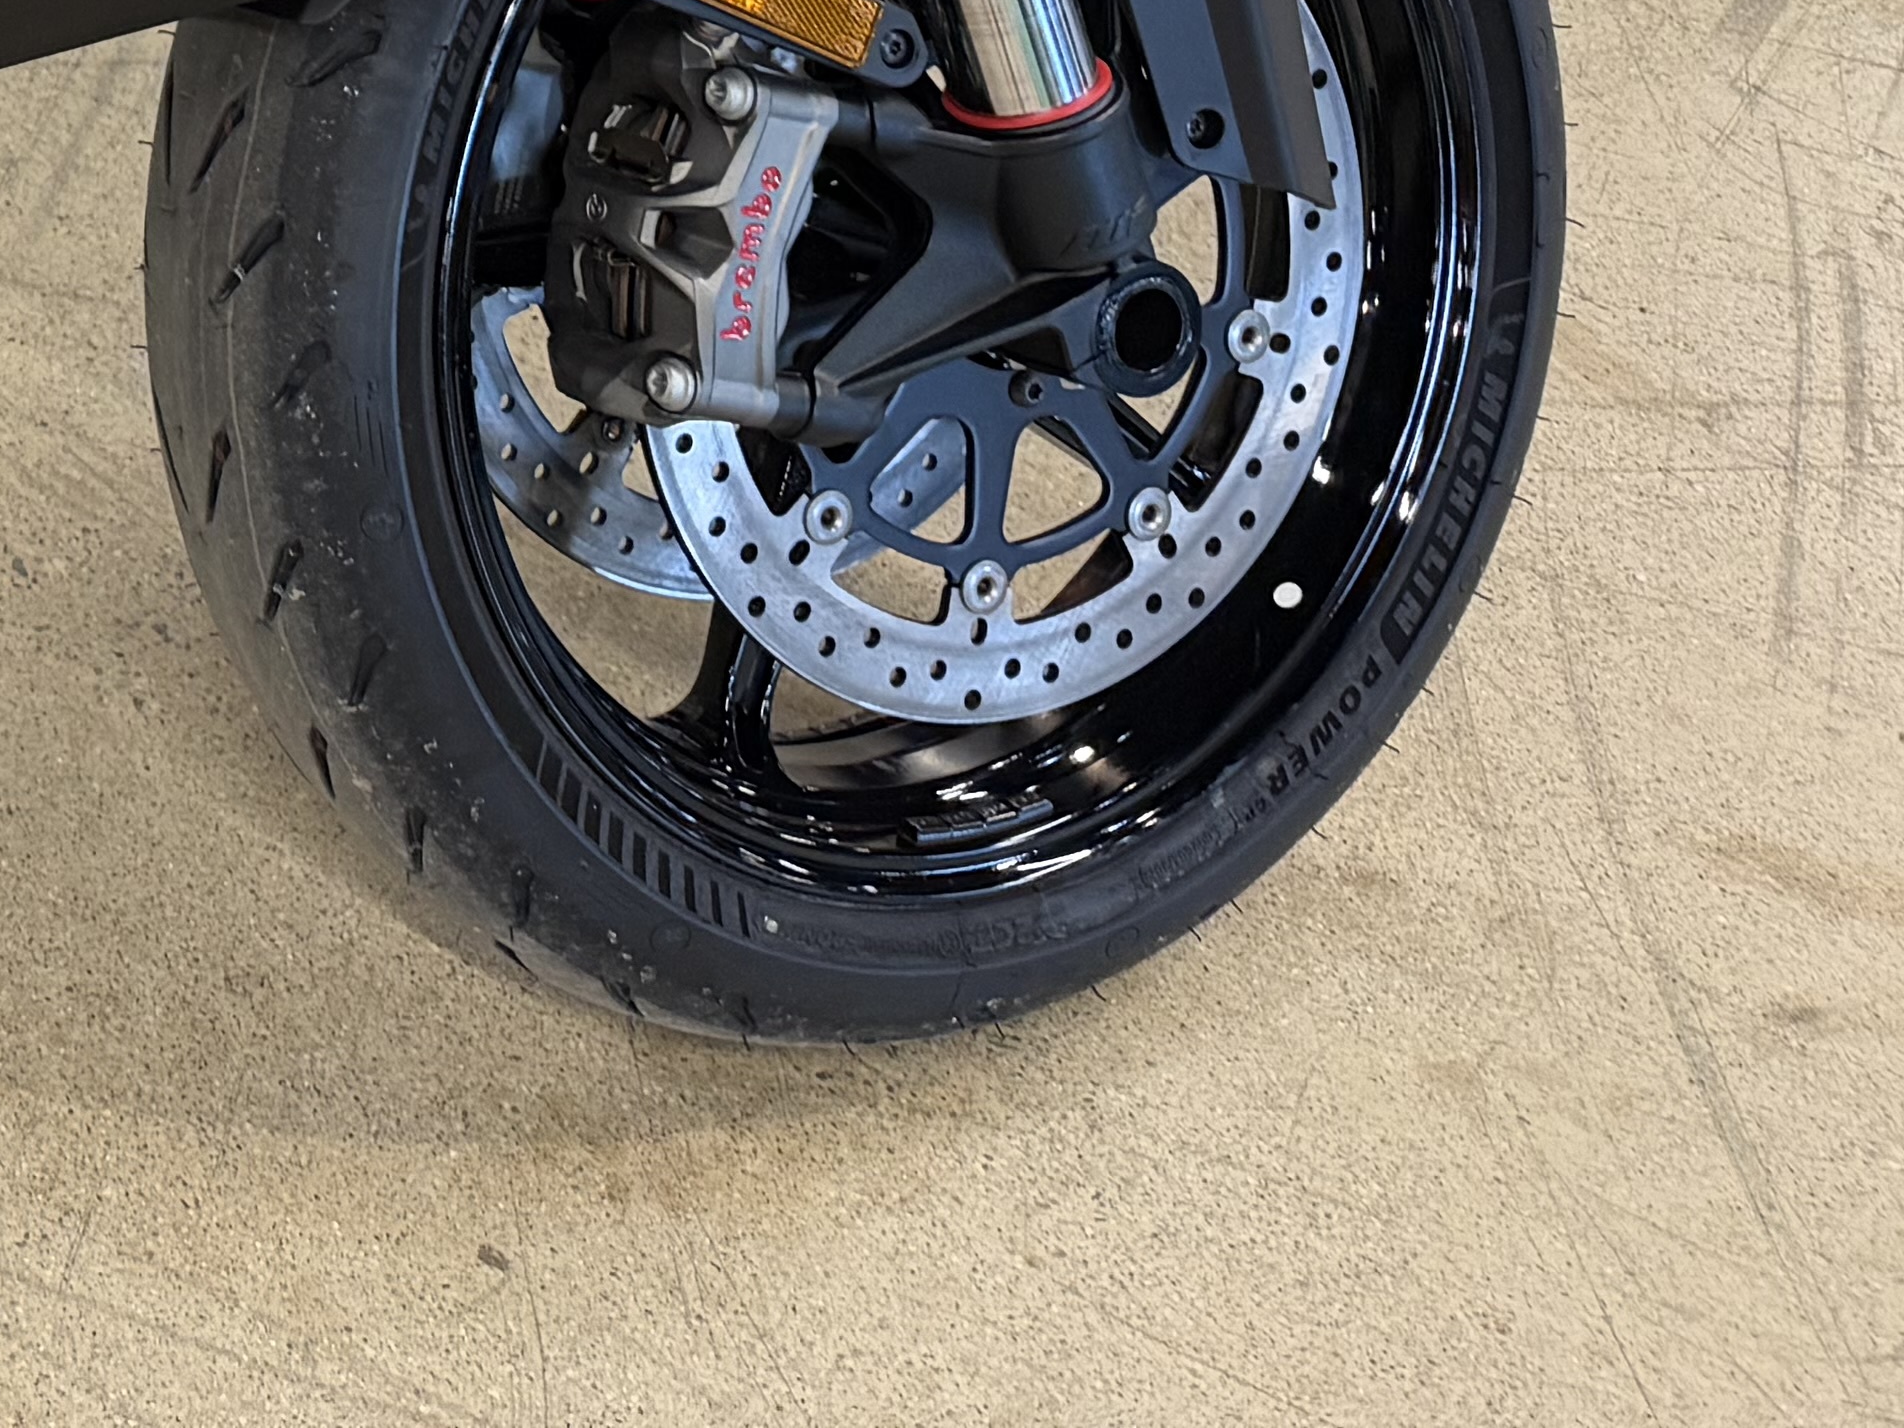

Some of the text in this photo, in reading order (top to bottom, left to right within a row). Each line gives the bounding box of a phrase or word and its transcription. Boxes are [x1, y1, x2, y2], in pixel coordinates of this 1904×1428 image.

[719, 165, 783, 342] brembo
[1391, 369, 1509, 638] MICHELIN
[1266, 653, 1383, 799] POWER
